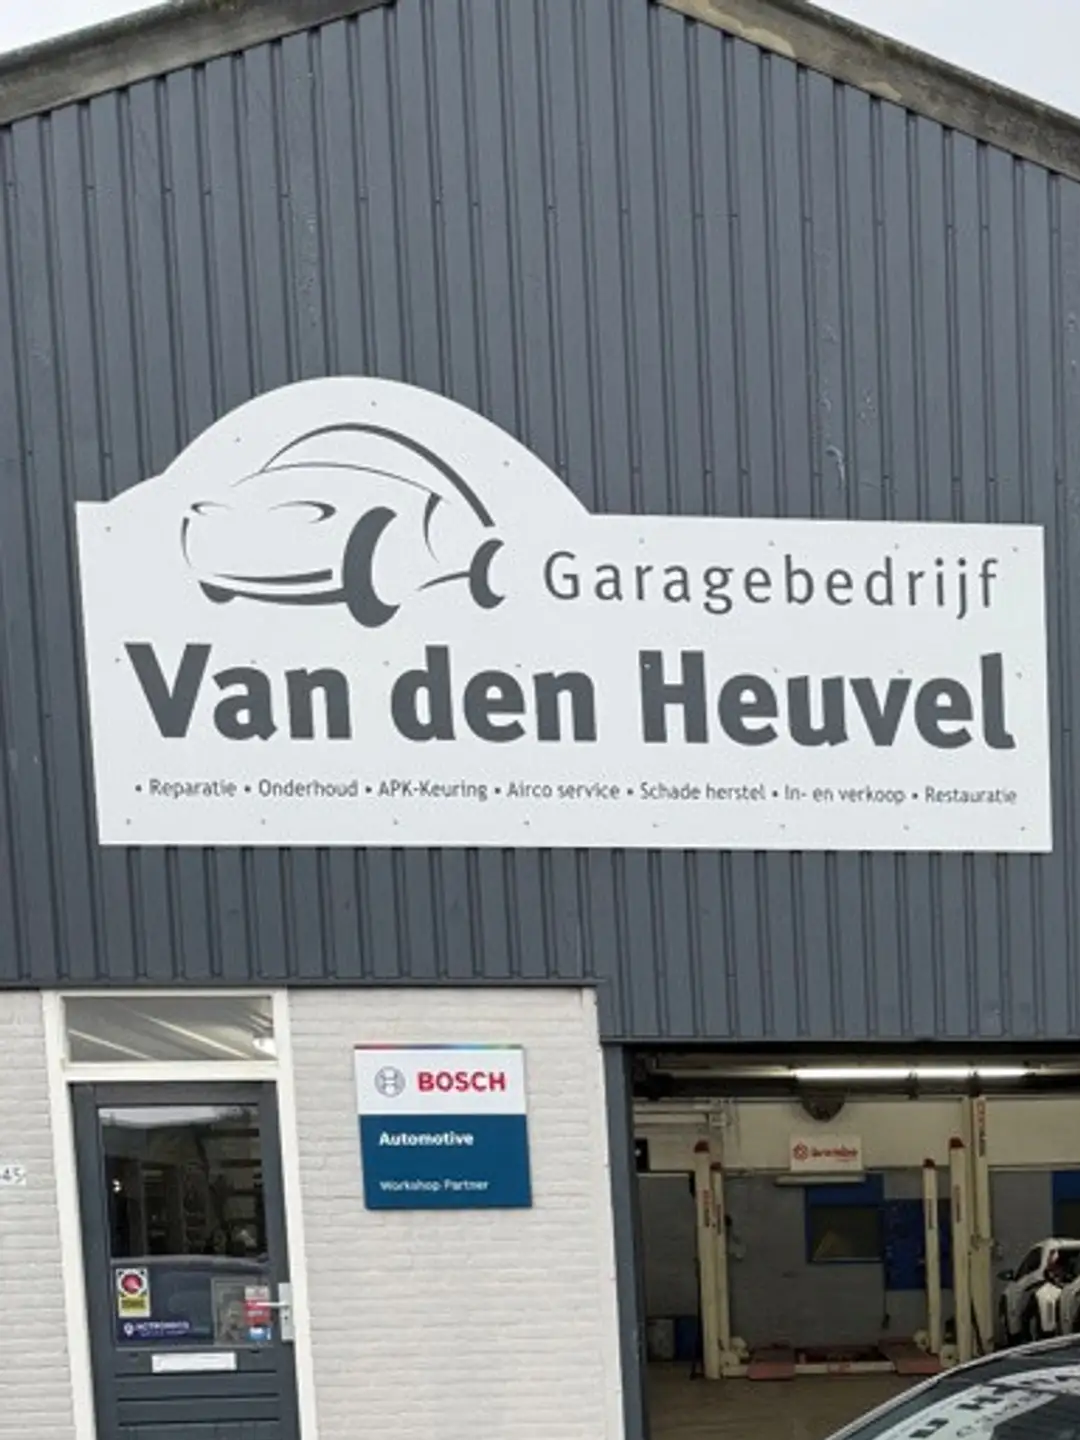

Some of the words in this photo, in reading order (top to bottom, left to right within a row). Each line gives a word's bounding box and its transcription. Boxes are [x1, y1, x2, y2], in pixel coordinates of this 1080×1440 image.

[543, 550, 999, 620] Garagebedrijf
[124, 642, 353, 741] Van
[390, 644, 597, 743] den
[639, 650, 1017, 750] Heuvel
[149, 778, 237, 800] Reparatie
[258, 778, 359, 798] Onderhoud
[378, 778, 488, 802] APK-Keuring
[506, 781, 553, 799] Airco
[557, 782, 620, 800] service
[640, 781, 702, 801] Schade
[705, 783, 767, 802] herstel
[784, 784, 807, 800] In-
[812, 787, 834, 803] en
[838, 786, 906, 805] verkoop
[925, 785, 1018, 805] Restauratie
[417, 1071, 507, 1093] BOSCH
[378, 1130, 475, 1147] Automotive
[379, 1178, 442, 1193] Workshop
[443, 1178, 490, 1192] Partner
